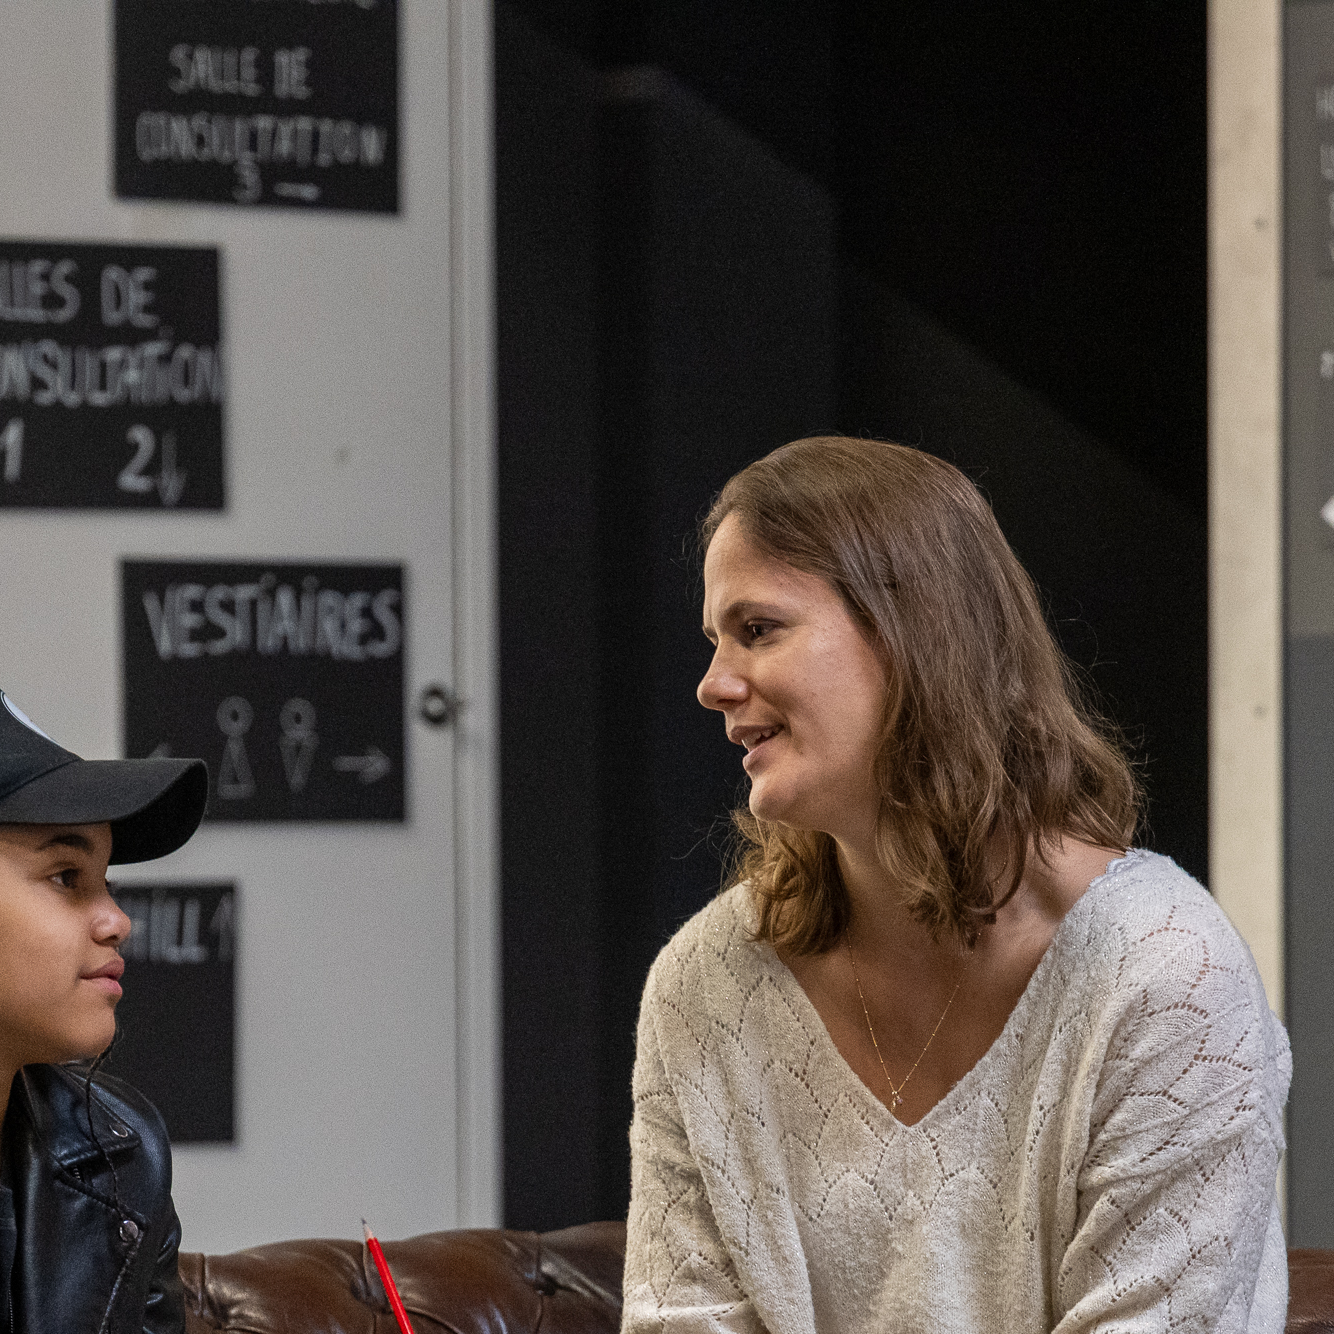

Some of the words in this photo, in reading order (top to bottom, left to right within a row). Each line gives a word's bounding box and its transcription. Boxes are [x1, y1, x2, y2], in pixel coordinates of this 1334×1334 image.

[168, 43, 263, 98] SALLE
[273, 46, 313, 99] DE
[135, 110, 388, 168] CONSULTATION
[101, 265, 161, 328] DE
[117, 424, 157, 494] 2
